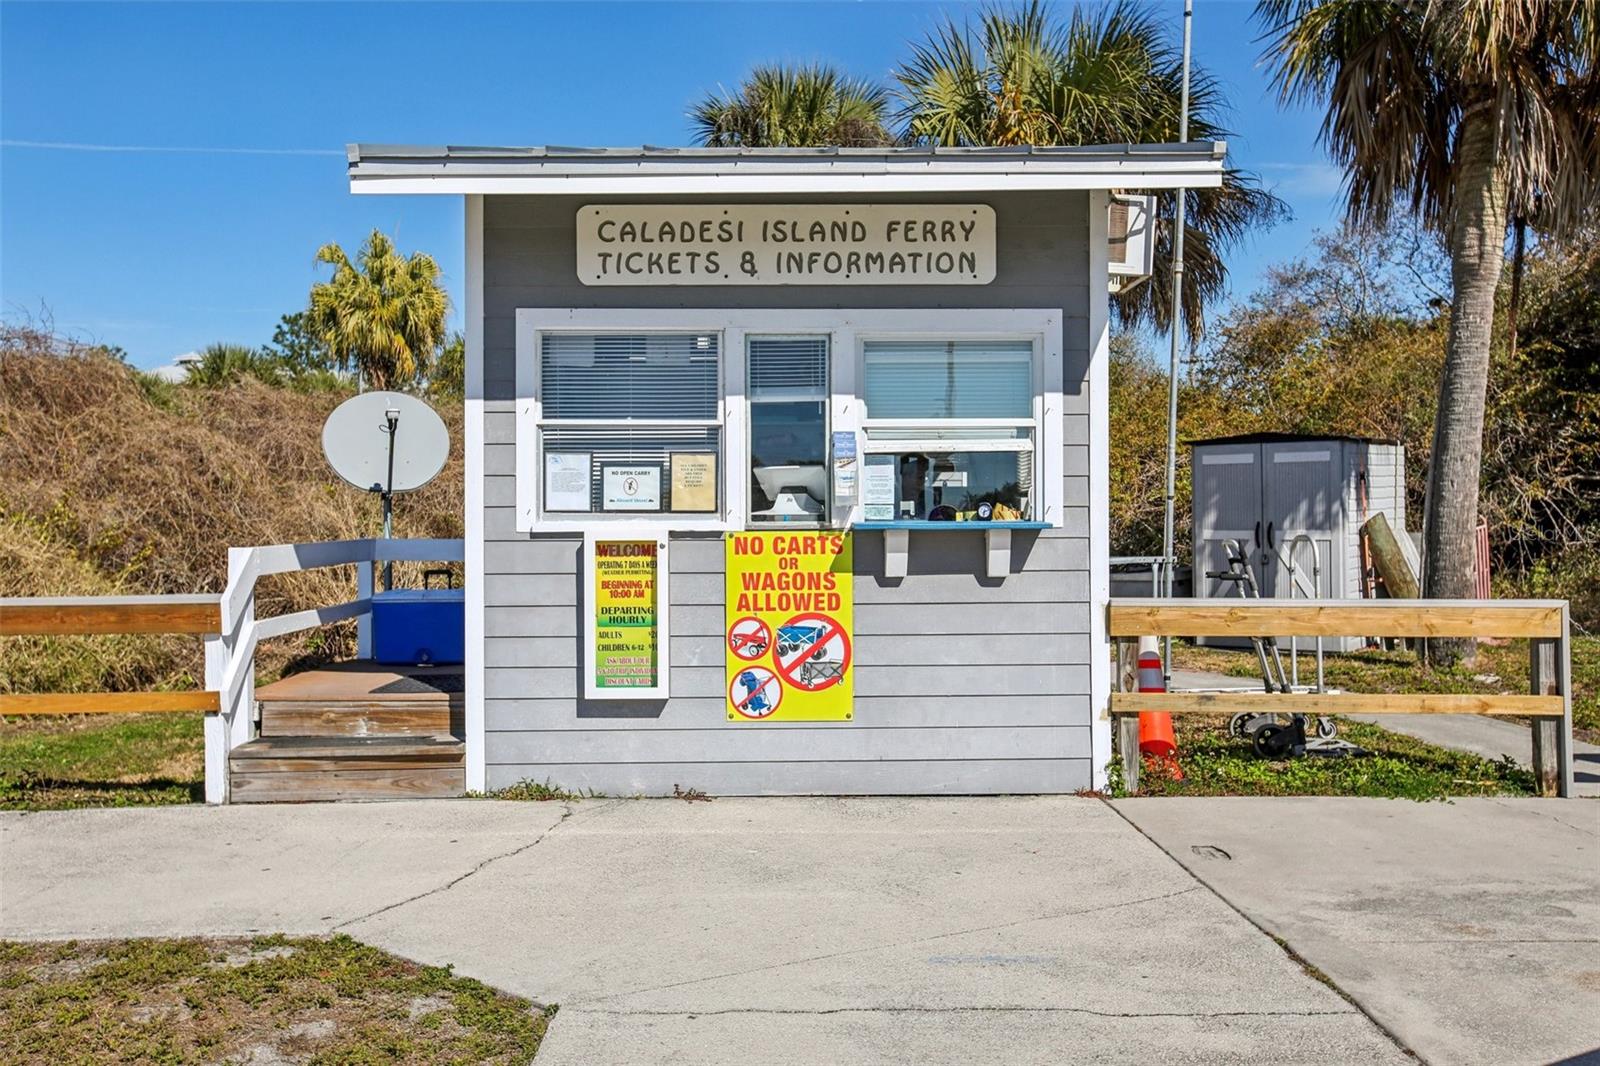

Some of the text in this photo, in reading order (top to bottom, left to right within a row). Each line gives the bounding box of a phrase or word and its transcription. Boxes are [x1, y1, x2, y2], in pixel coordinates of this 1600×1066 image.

[597, 220, 977, 243] CALADESI ISLAND FERRY
[597, 251, 977, 277] TICKETS & INFORMATION
[597, 543, 657, 557] WELCOME
[734, 536, 843, 555] NO CARTS
[778, 557, 798, 570] OR
[601, 580, 655, 590] BEGINNING AT
[741, 572, 837, 591] WAGONS
[609, 590, 645, 599] 10:00 AM
[736, 593, 841, 612] ALLOWED
[601, 607, 655, 615] DEPARTING
[608, 616, 647, 625] HOURLY
[598, 631, 623, 639] ADULTS
[598, 644, 630, 652] CHILDREN
